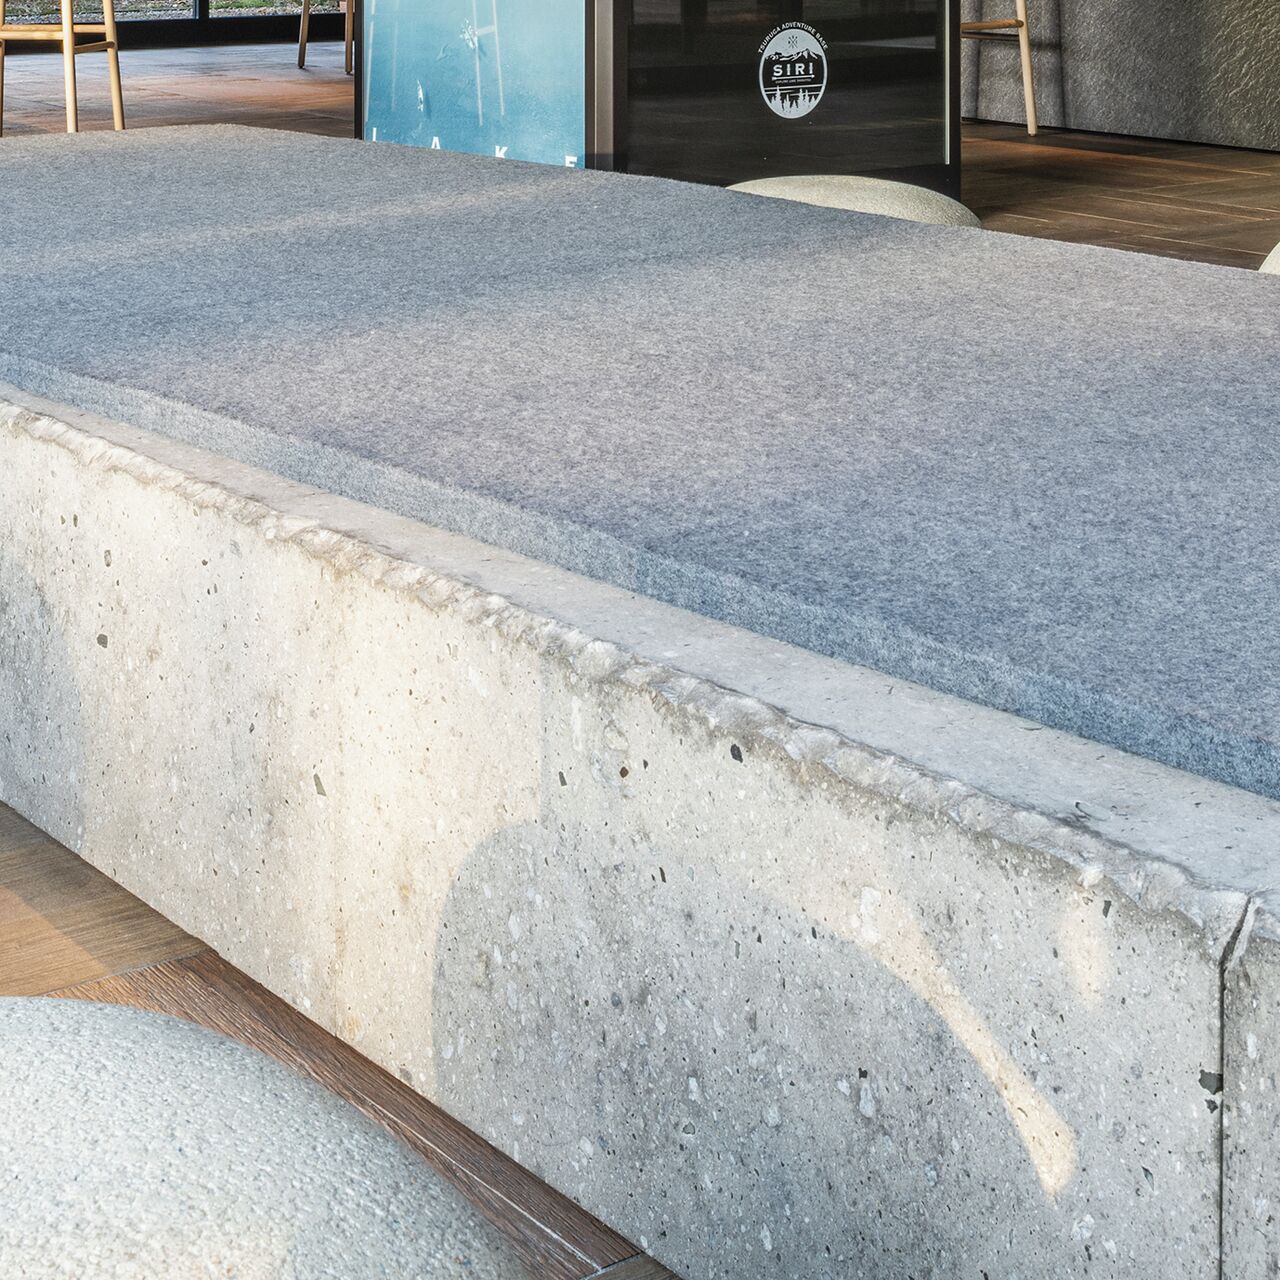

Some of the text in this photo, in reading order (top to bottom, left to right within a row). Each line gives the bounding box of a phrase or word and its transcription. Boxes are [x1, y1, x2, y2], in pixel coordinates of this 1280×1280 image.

[758, 22, 828, 53] TSURUGA ADVENTURE BASE
[773, 62, 813, 76] SIRI
